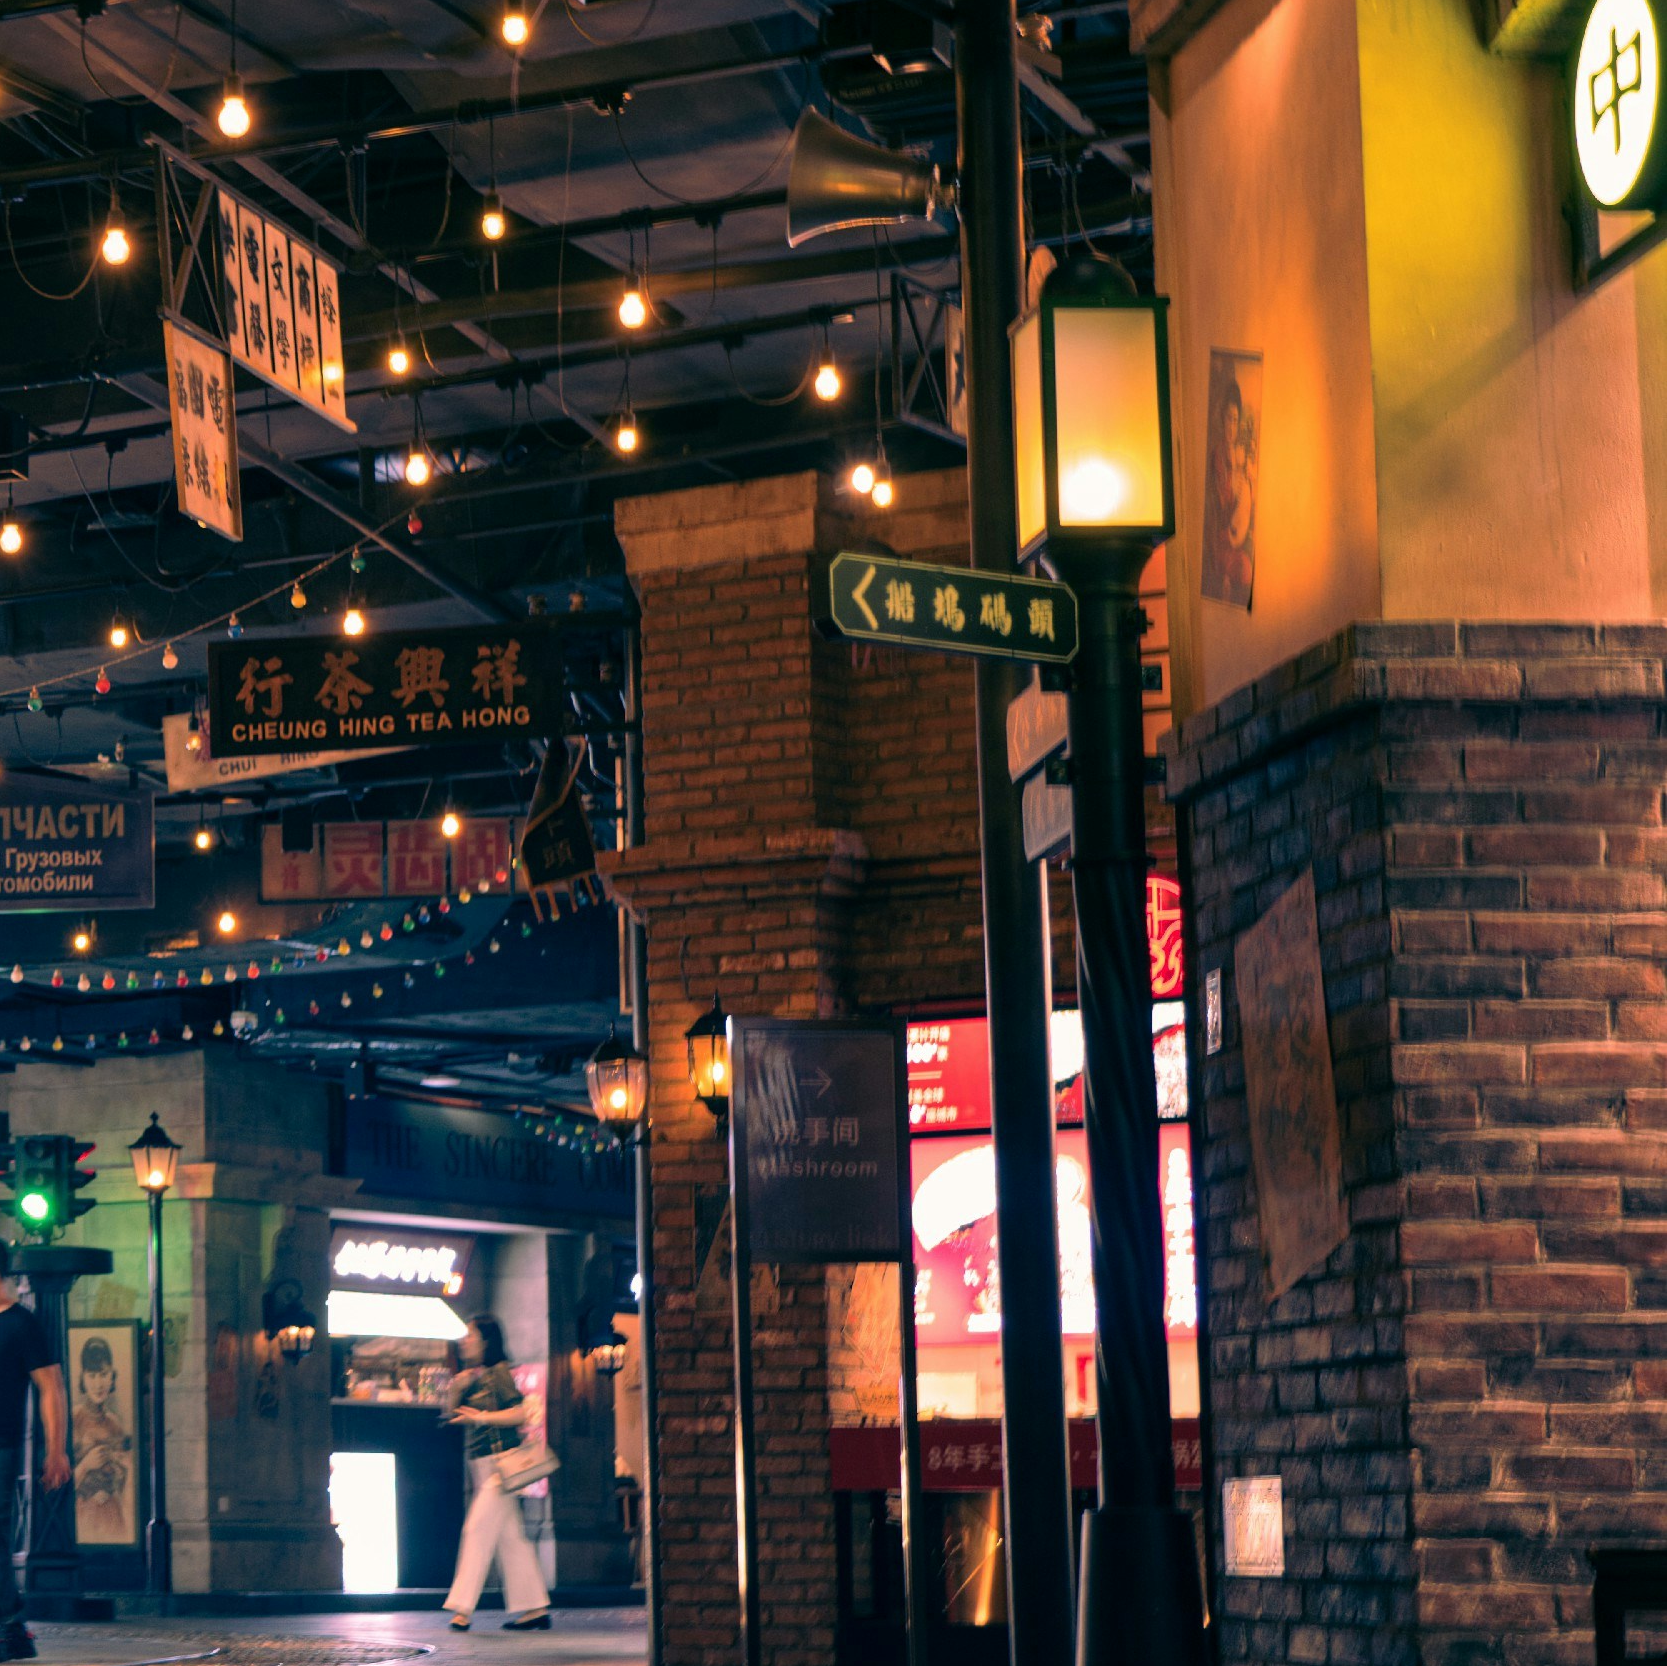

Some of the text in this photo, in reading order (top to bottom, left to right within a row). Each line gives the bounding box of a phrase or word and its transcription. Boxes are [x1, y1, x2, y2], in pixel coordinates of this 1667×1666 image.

[1588, 26, 1643, 156] 中
[232, 719, 327, 743] CHEUNG
[339, 715, 395, 738] HING
[406, 711, 453, 733] TEA
[462, 705, 531, 728] HONG
[218, 757, 257, 776] CHUI
[5, 847, 103, 873] Грузовых
[368, 1119, 422, 1170] THE
